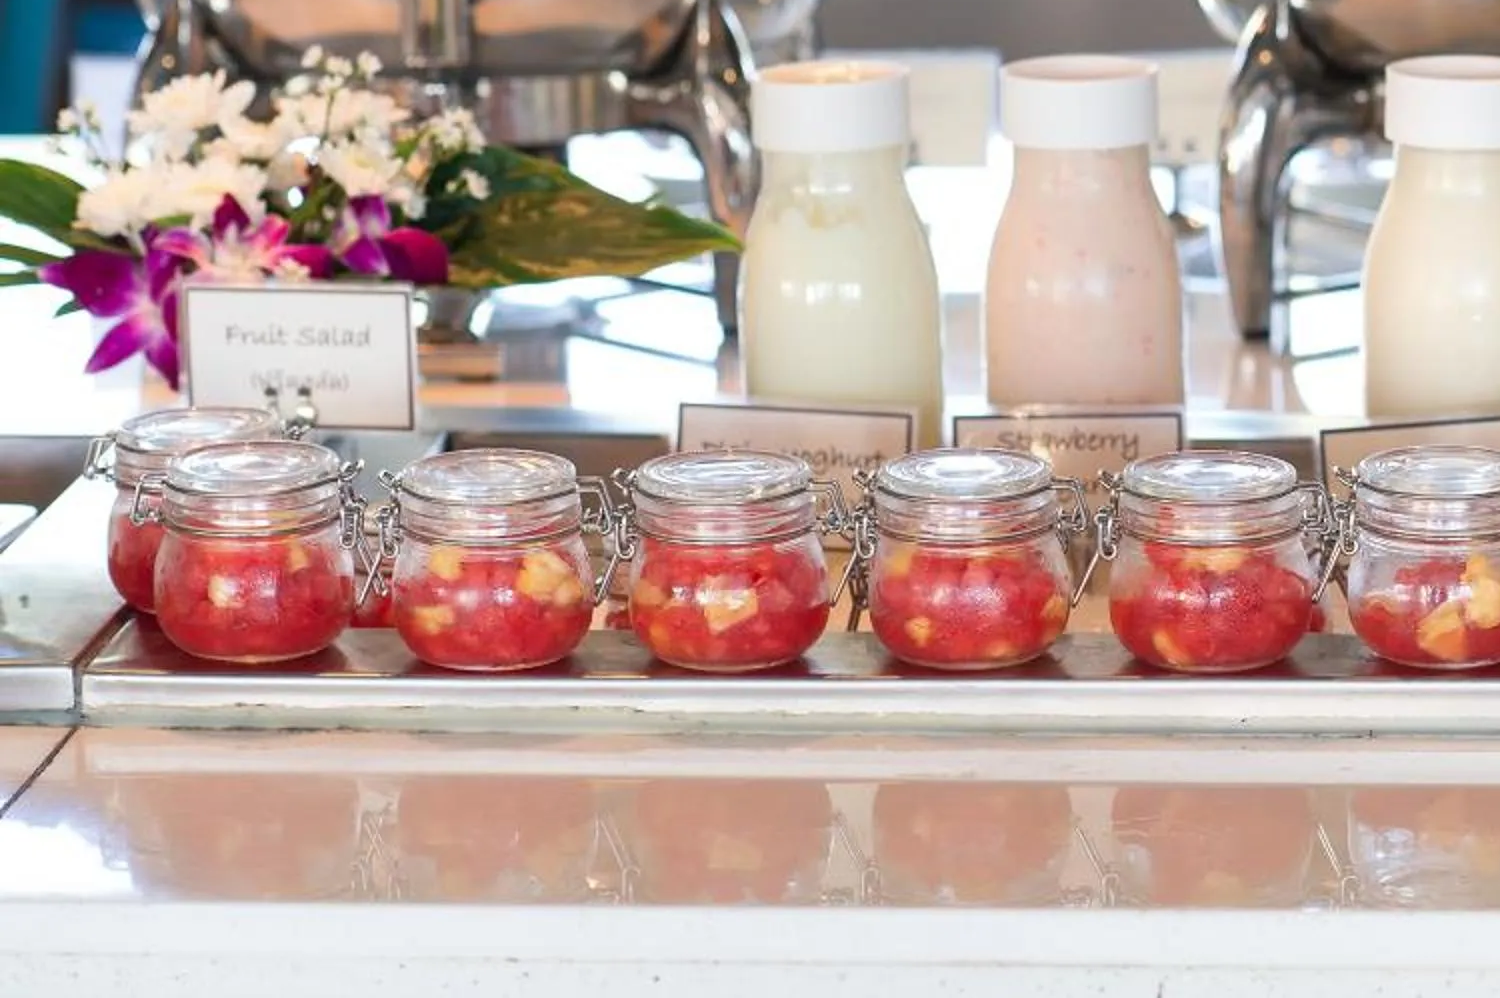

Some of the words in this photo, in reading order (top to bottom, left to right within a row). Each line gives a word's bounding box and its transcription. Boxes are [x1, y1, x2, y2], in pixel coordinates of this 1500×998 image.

[225, 323, 289, 345] Fruit
[295, 324, 371, 347] Salad
[782, 442, 883, 475] oghurt
